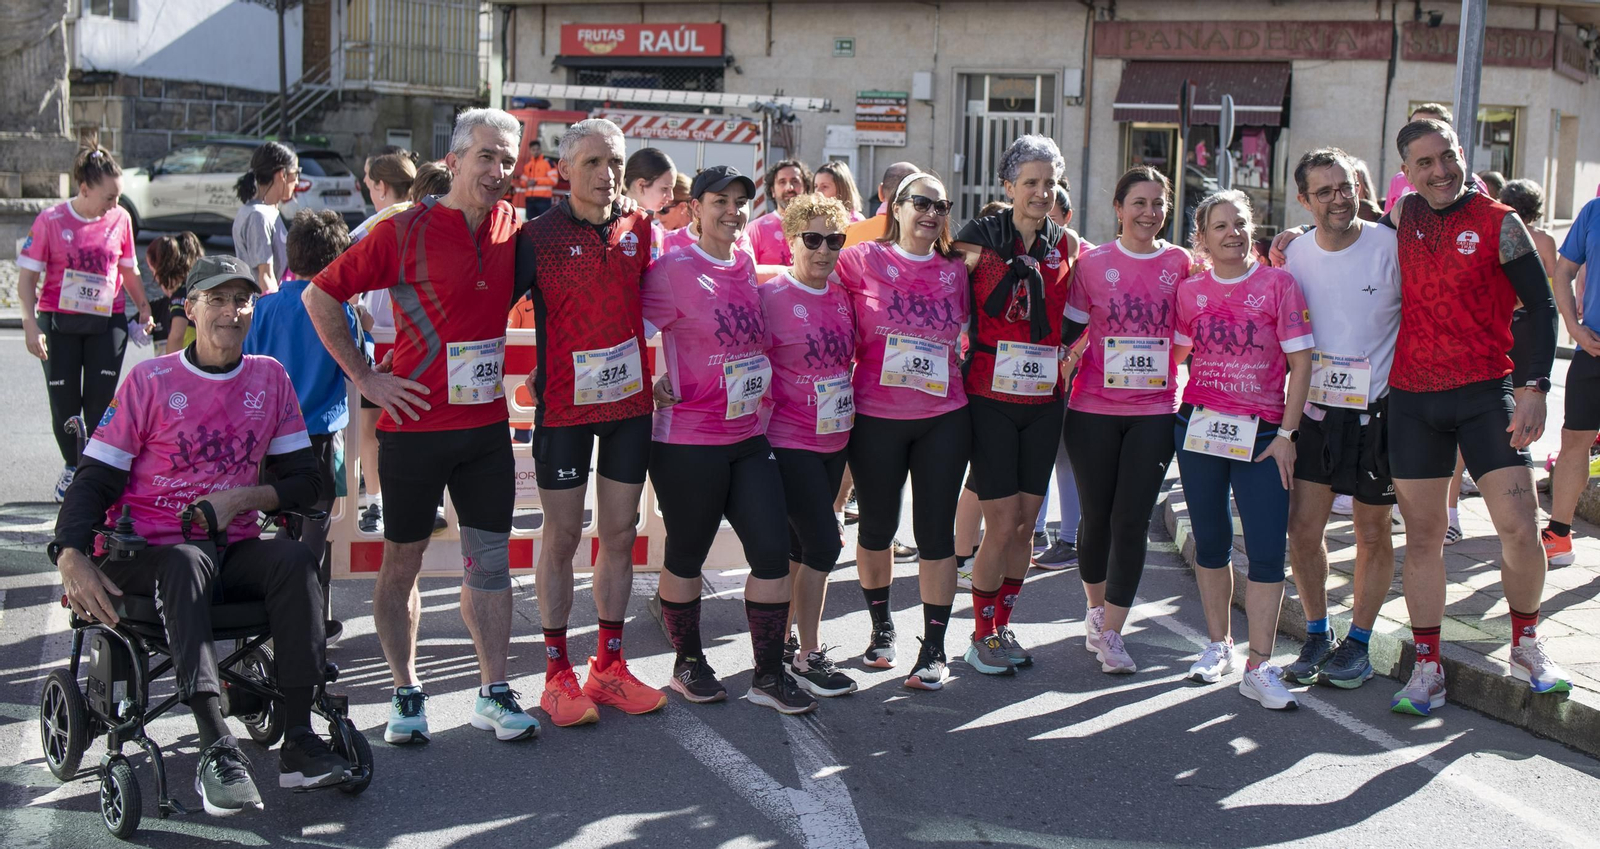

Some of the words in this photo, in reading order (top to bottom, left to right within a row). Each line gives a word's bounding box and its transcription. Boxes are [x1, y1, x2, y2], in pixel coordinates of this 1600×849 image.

[578, 29, 625, 42] FRUTAS
[639, 26, 704, 52] RAÚL
[692, 129, 716, 140] CIVIL
[450, 347, 459, 356] III
[708, 354, 724, 366] III
[913, 357, 930, 370] 93
[1130, 355, 1152, 367] 181
[476, 361, 499, 378] 236
[602, 363, 626, 381] 374
[1023, 362, 1039, 374] 68
[746, 376, 762, 392] 152
[795, 375, 812, 384] III
[1331, 372, 1348, 384] 67
[1212, 421, 1238, 436] 133
[152, 475, 171, 487] III
